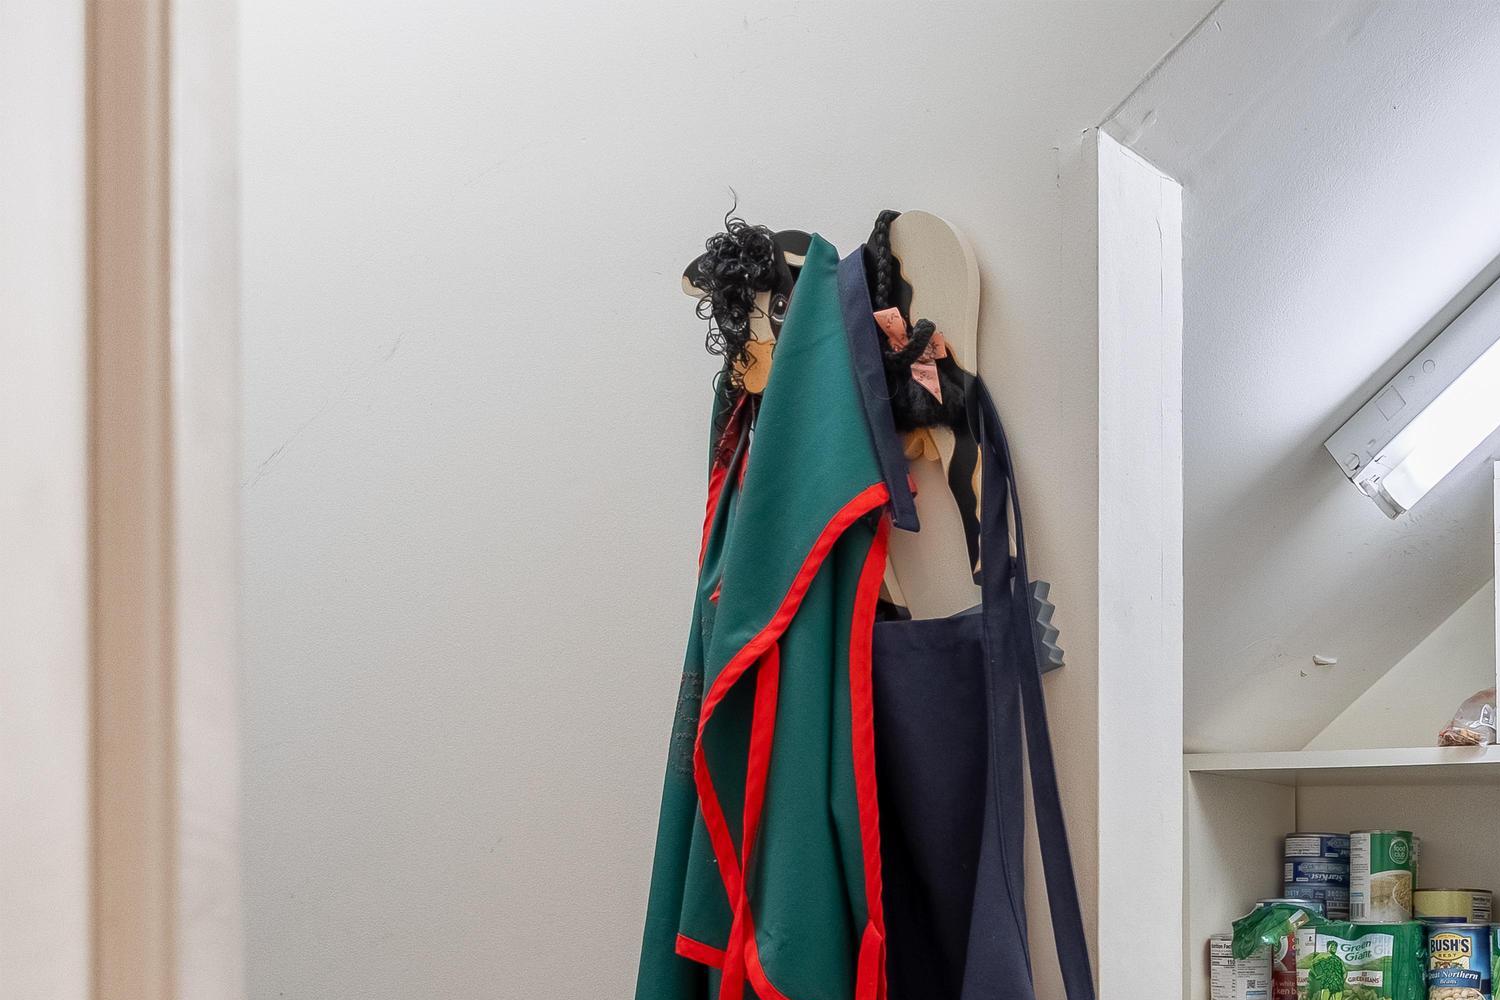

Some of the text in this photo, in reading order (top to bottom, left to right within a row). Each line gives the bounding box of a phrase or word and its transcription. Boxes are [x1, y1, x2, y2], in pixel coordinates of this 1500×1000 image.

[1340, 941, 1372, 952] Green
[1430, 938, 1470, 953] BUSH'S
[1345, 951, 1373, 961] Giant
